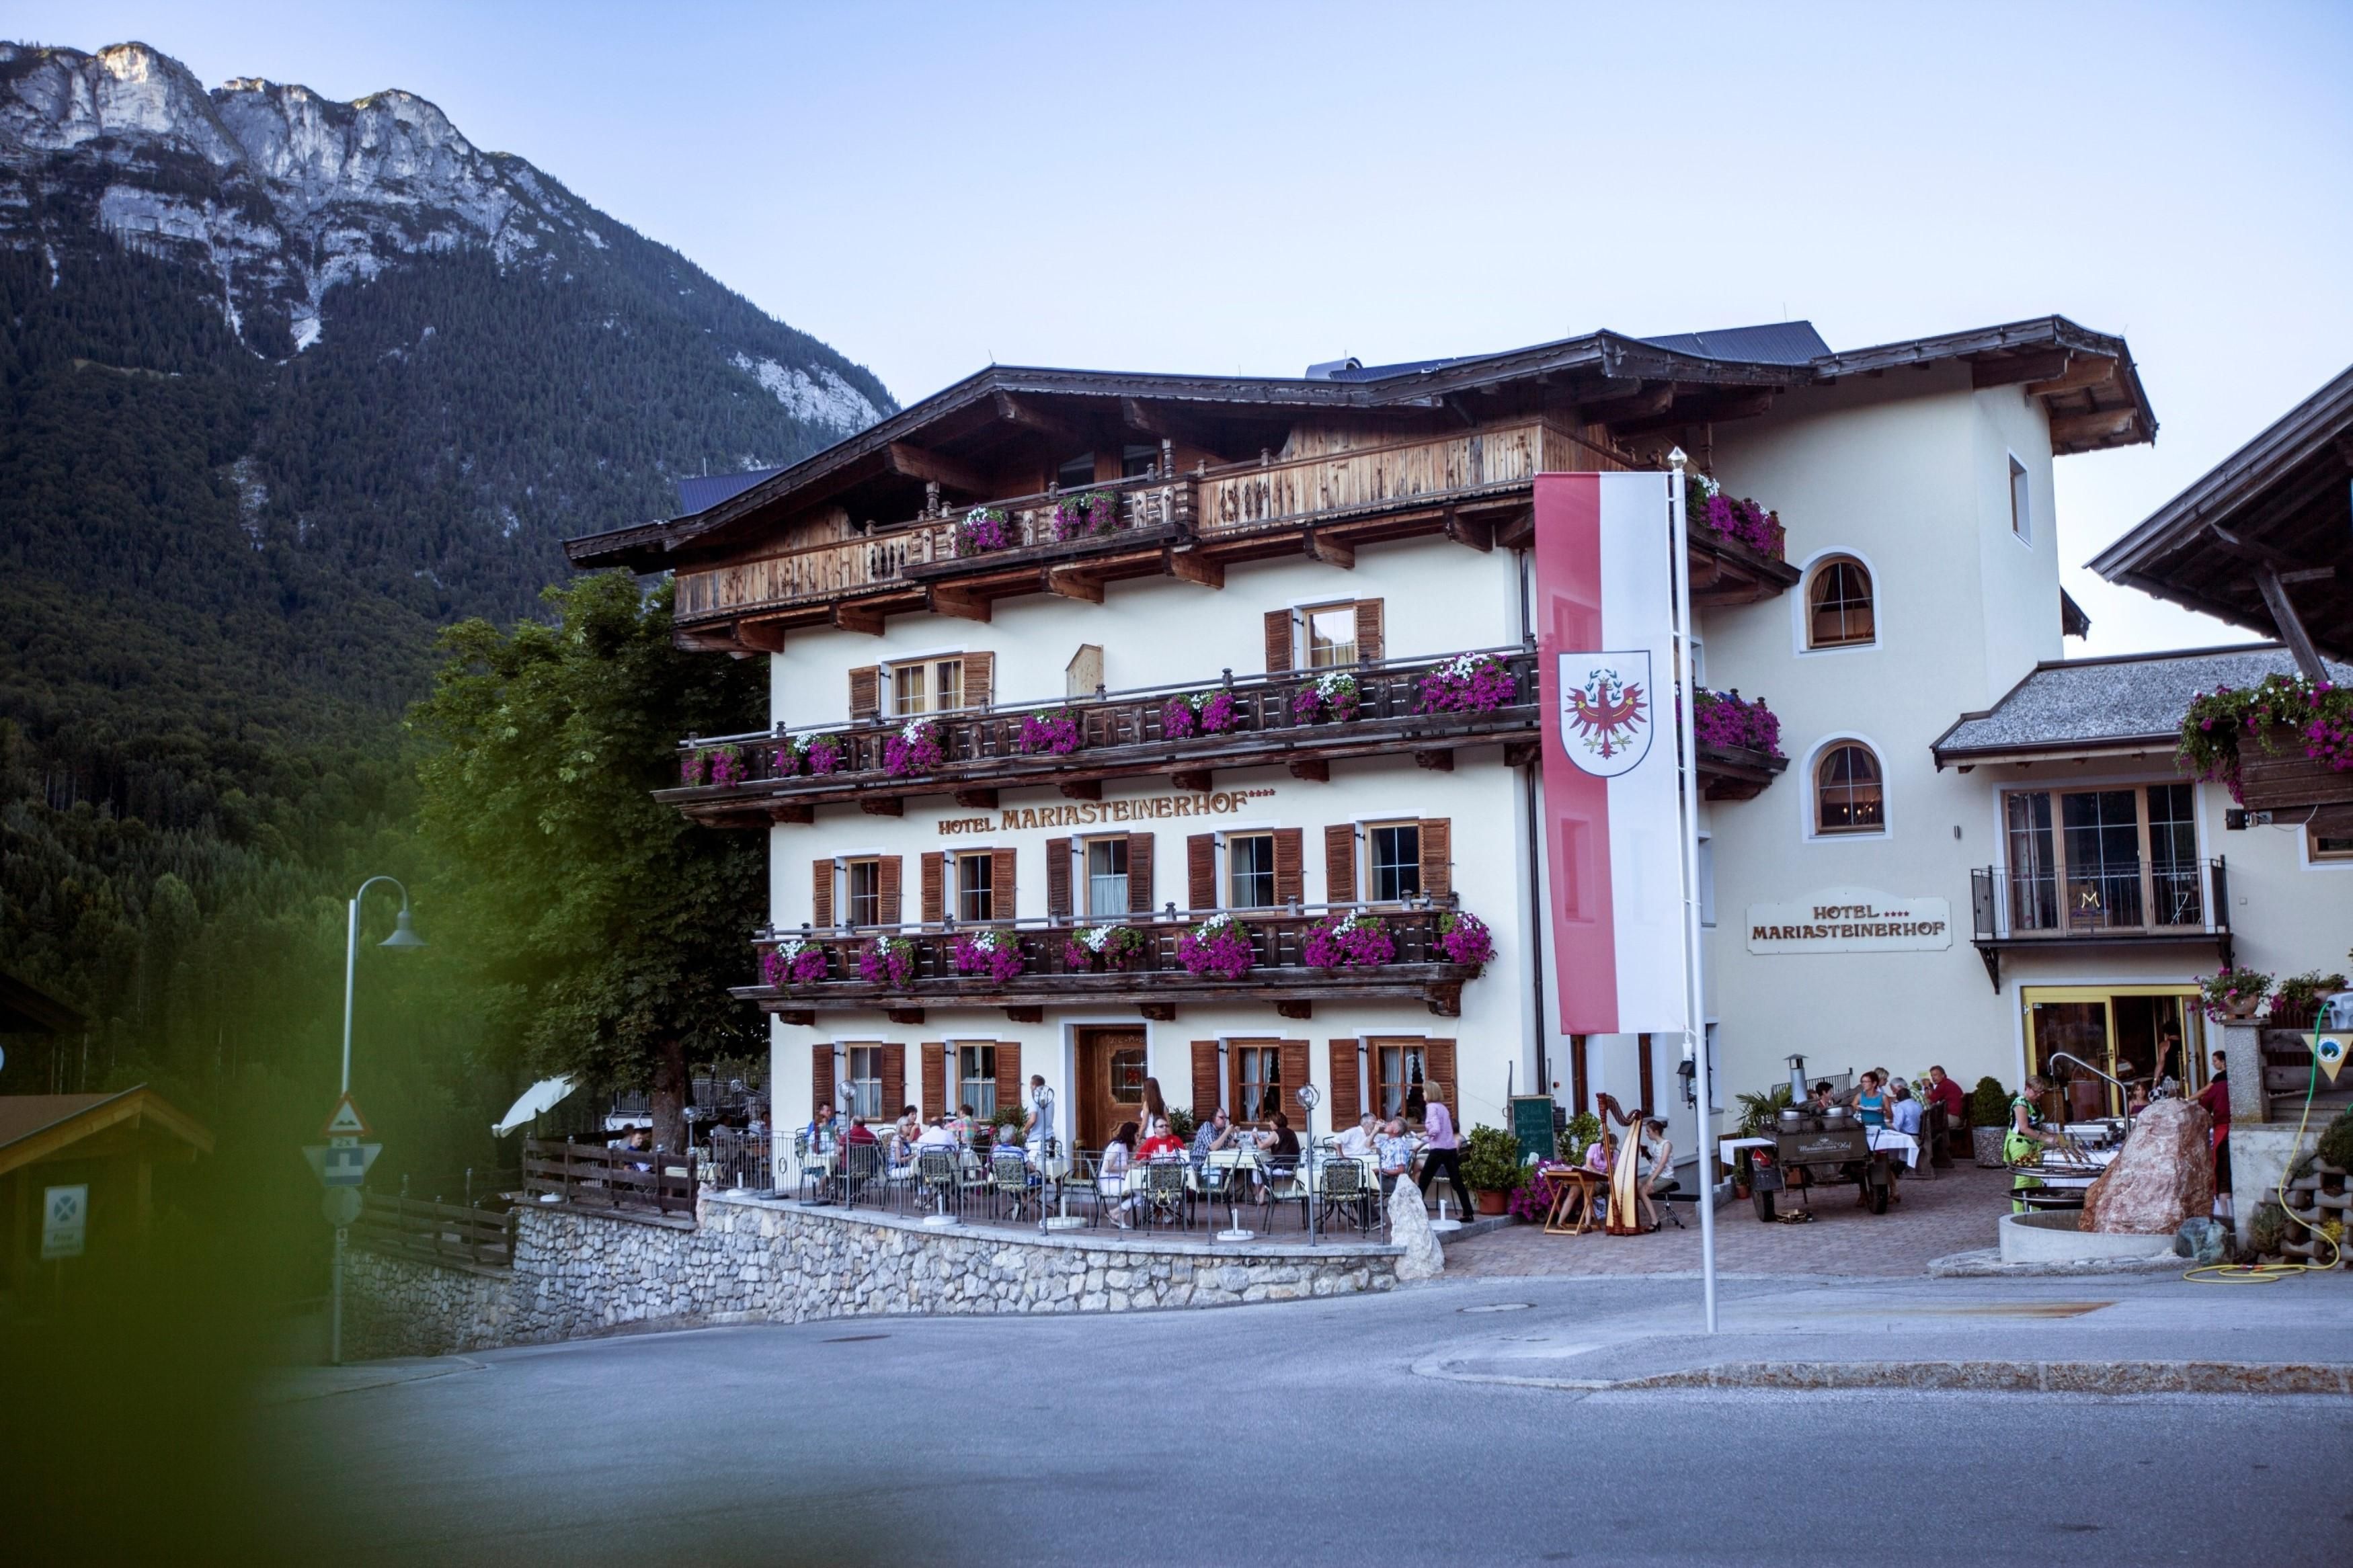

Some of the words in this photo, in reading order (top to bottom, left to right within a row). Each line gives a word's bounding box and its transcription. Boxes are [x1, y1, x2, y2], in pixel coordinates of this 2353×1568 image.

[939, 817, 996, 835] HOTEL
[1001, 791, 1247, 830] MARIASTEINERHOF
[1813, 905, 1880, 919] HOTEL
[1752, 921, 1945, 940] MARIASTEINERHOF
